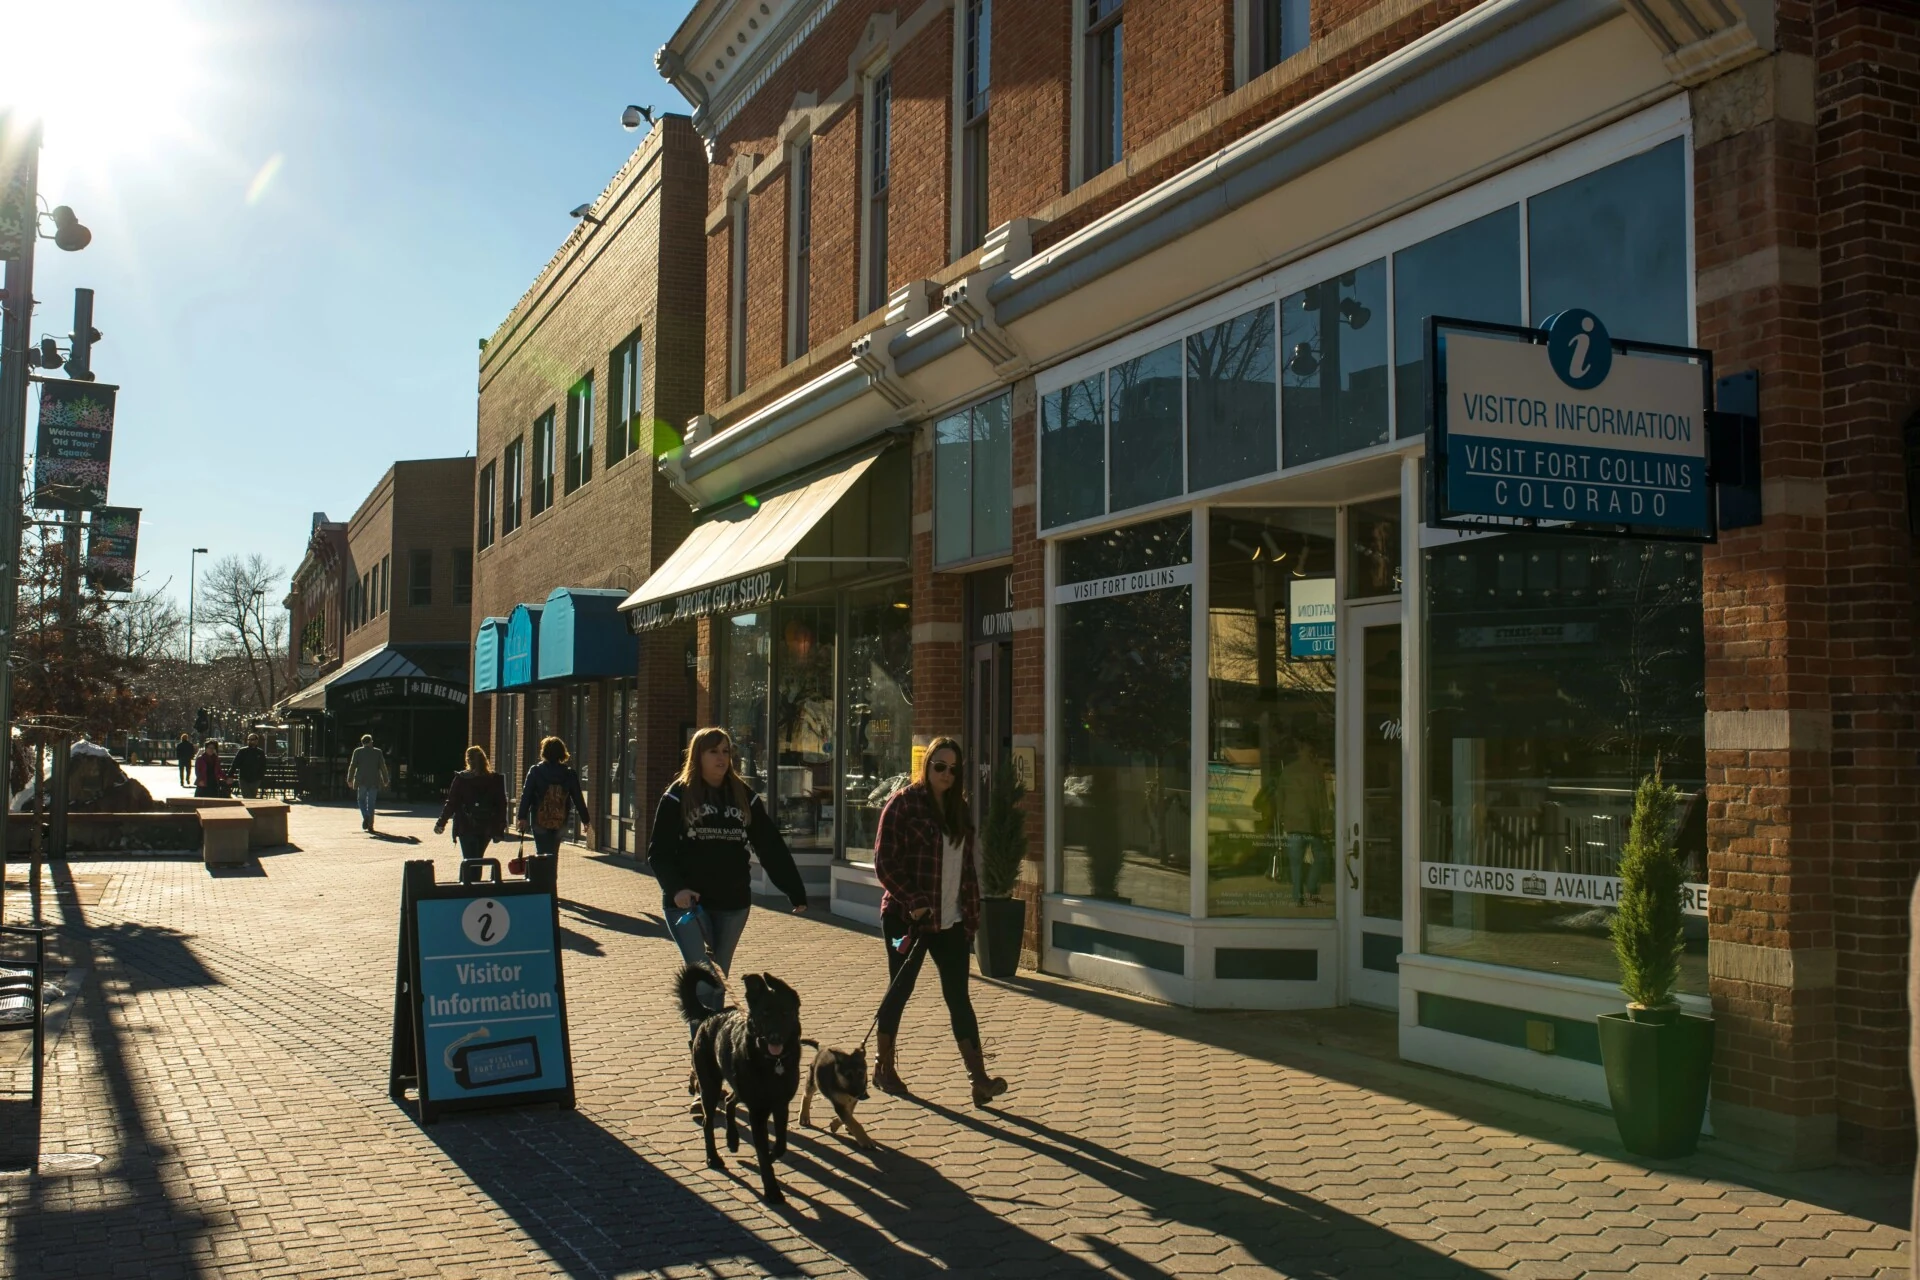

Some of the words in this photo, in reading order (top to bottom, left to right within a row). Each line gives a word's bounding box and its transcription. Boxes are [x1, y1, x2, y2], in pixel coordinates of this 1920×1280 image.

[1463, 393, 1548, 428] VISITOR
[1555, 403, 1691, 442] INFORMATION
[49, 428, 89, 438] Welcome
[52, 438, 68, 447] Old
[71, 439, 96, 448] Town
[1465, 445, 1526, 474] VISIT
[1535, 451, 1591, 479] FORT
[1599, 457, 1692, 488] COLLINS
[1495, 481, 1666, 516] COLORADO
[713, 581, 738, 609] GIFT
[739, 572, 771, 601] SHOP
[1074, 582, 1099, 599] VISIT
[1102, 577, 1127, 594] FORT
[1131, 570, 1174, 590] COLLINS
[982, 614, 995, 636] OLD
[350, 687, 368, 703] YETI
[420, 682, 432, 694] THE
[434, 685, 447, 698] REC
[447, 688, 468, 705] ROOM
[1428, 866, 1460, 887] GIFT
[1463, 870, 1515, 892] CARDS
[456, 963, 522, 985] Visitor
[430, 990, 552, 1017] Information
